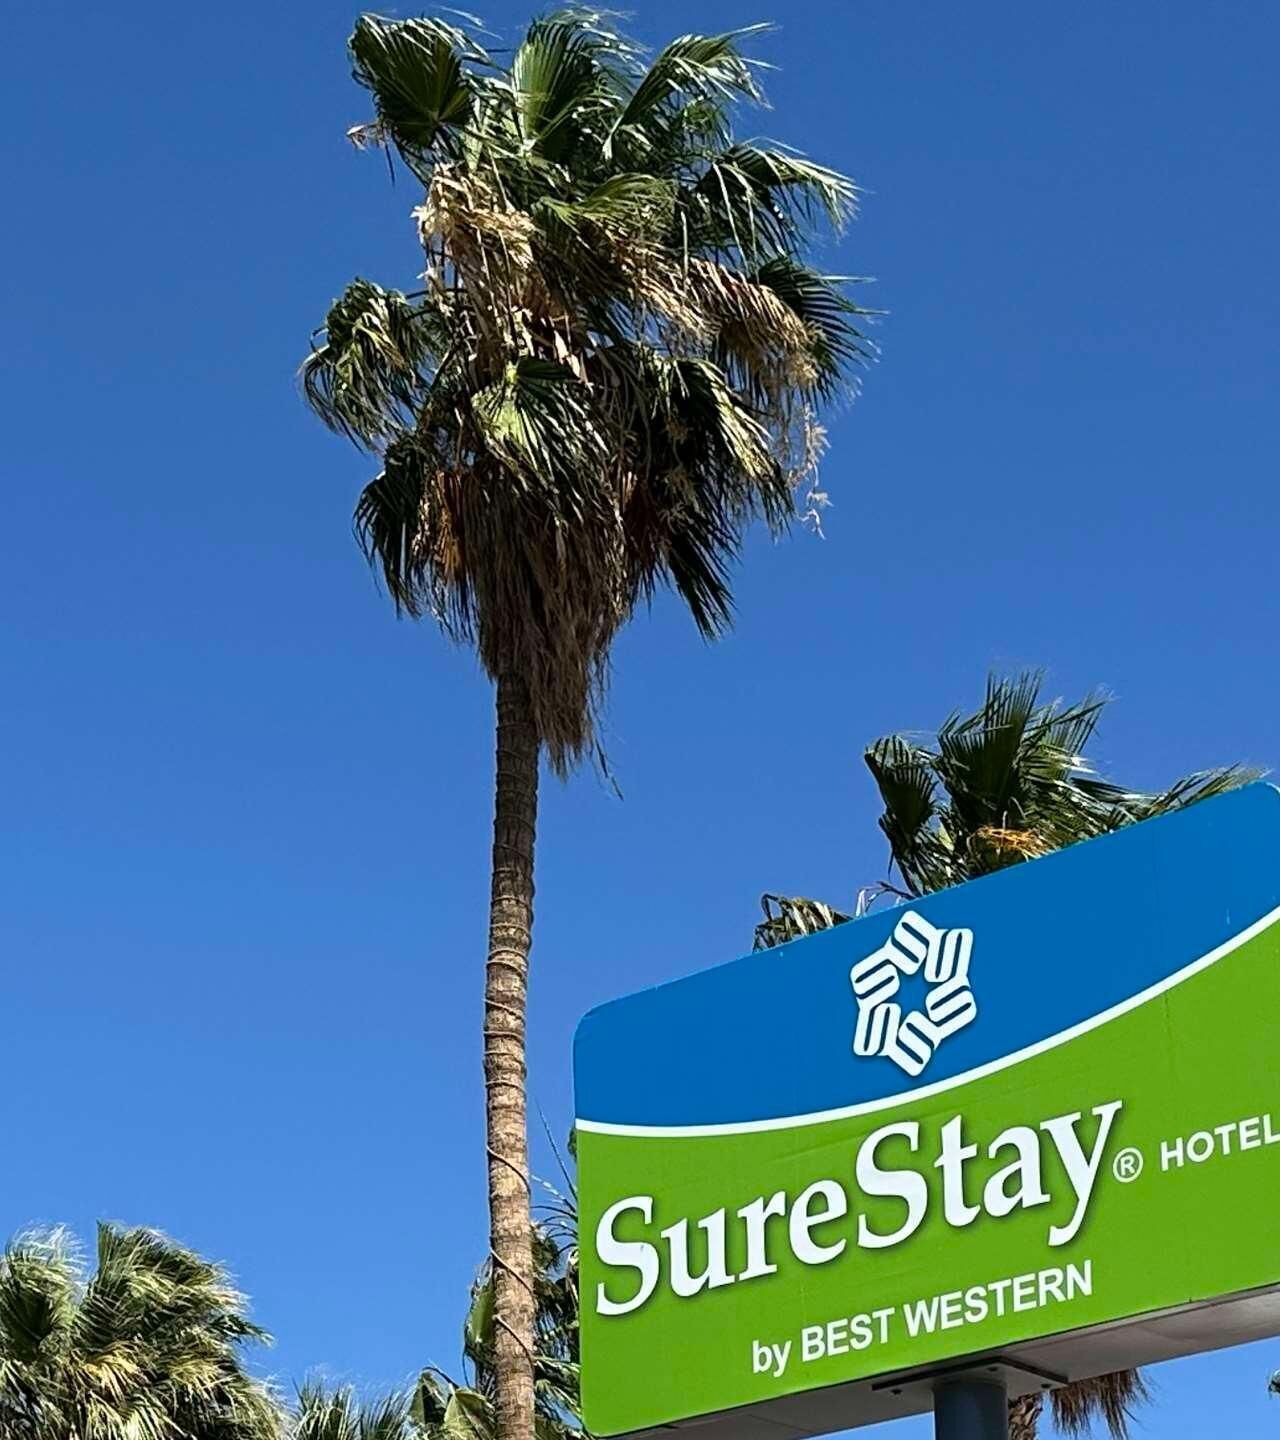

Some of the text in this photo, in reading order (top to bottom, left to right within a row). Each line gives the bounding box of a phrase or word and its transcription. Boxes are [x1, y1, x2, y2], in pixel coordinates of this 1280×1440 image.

[752, 1259, 1093, 1377] by BEST WESTERN
